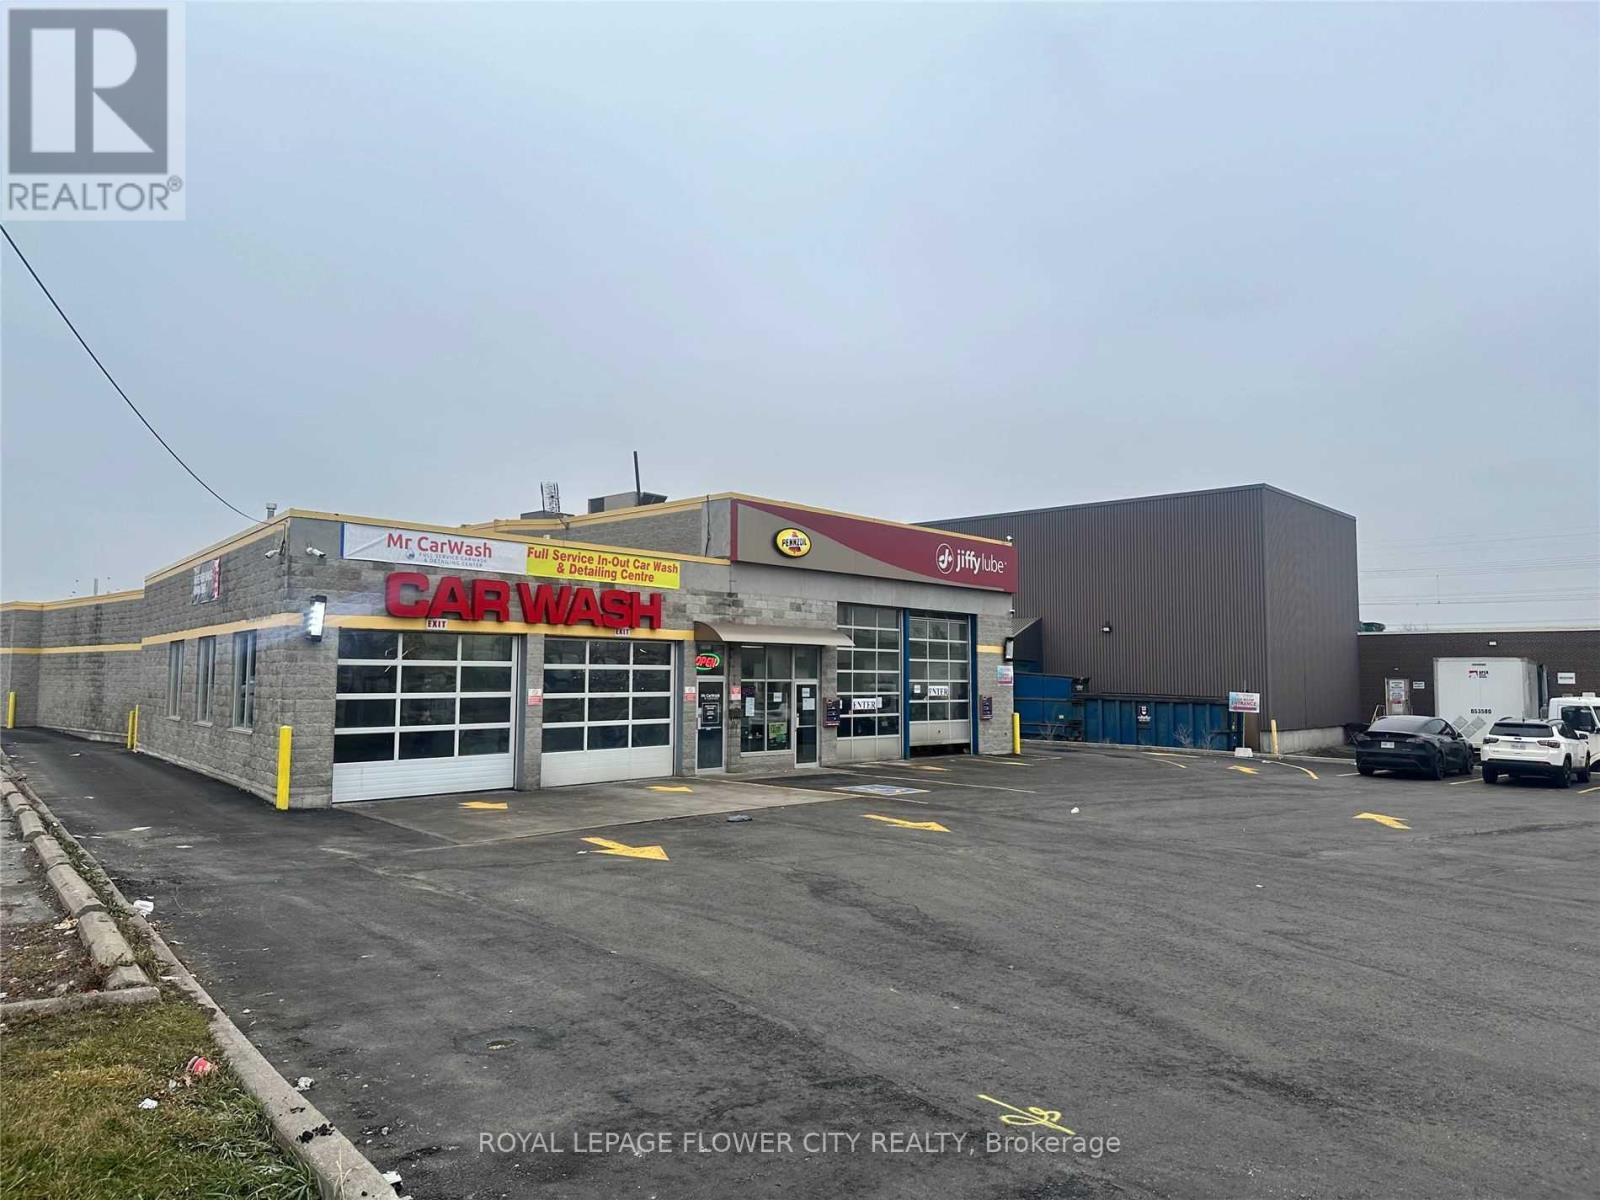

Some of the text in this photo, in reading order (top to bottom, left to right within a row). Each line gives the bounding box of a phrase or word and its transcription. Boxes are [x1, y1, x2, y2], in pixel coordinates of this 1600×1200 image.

[387, 532, 493, 559] Mr CarWash
[429, 558, 460, 566] DETAILING
[460, 555, 487, 563] CARWASH
[528, 547, 678, 574] Full Service In-Out Car Wash
[556, 562, 655, 583] & Detailing Centre
[385, 571, 662, 630] CAR WASH
[427, 620, 447, 629] EXIT
[695, 655, 717, 668] OPEN
[853, 700, 876, 709] ENTER
